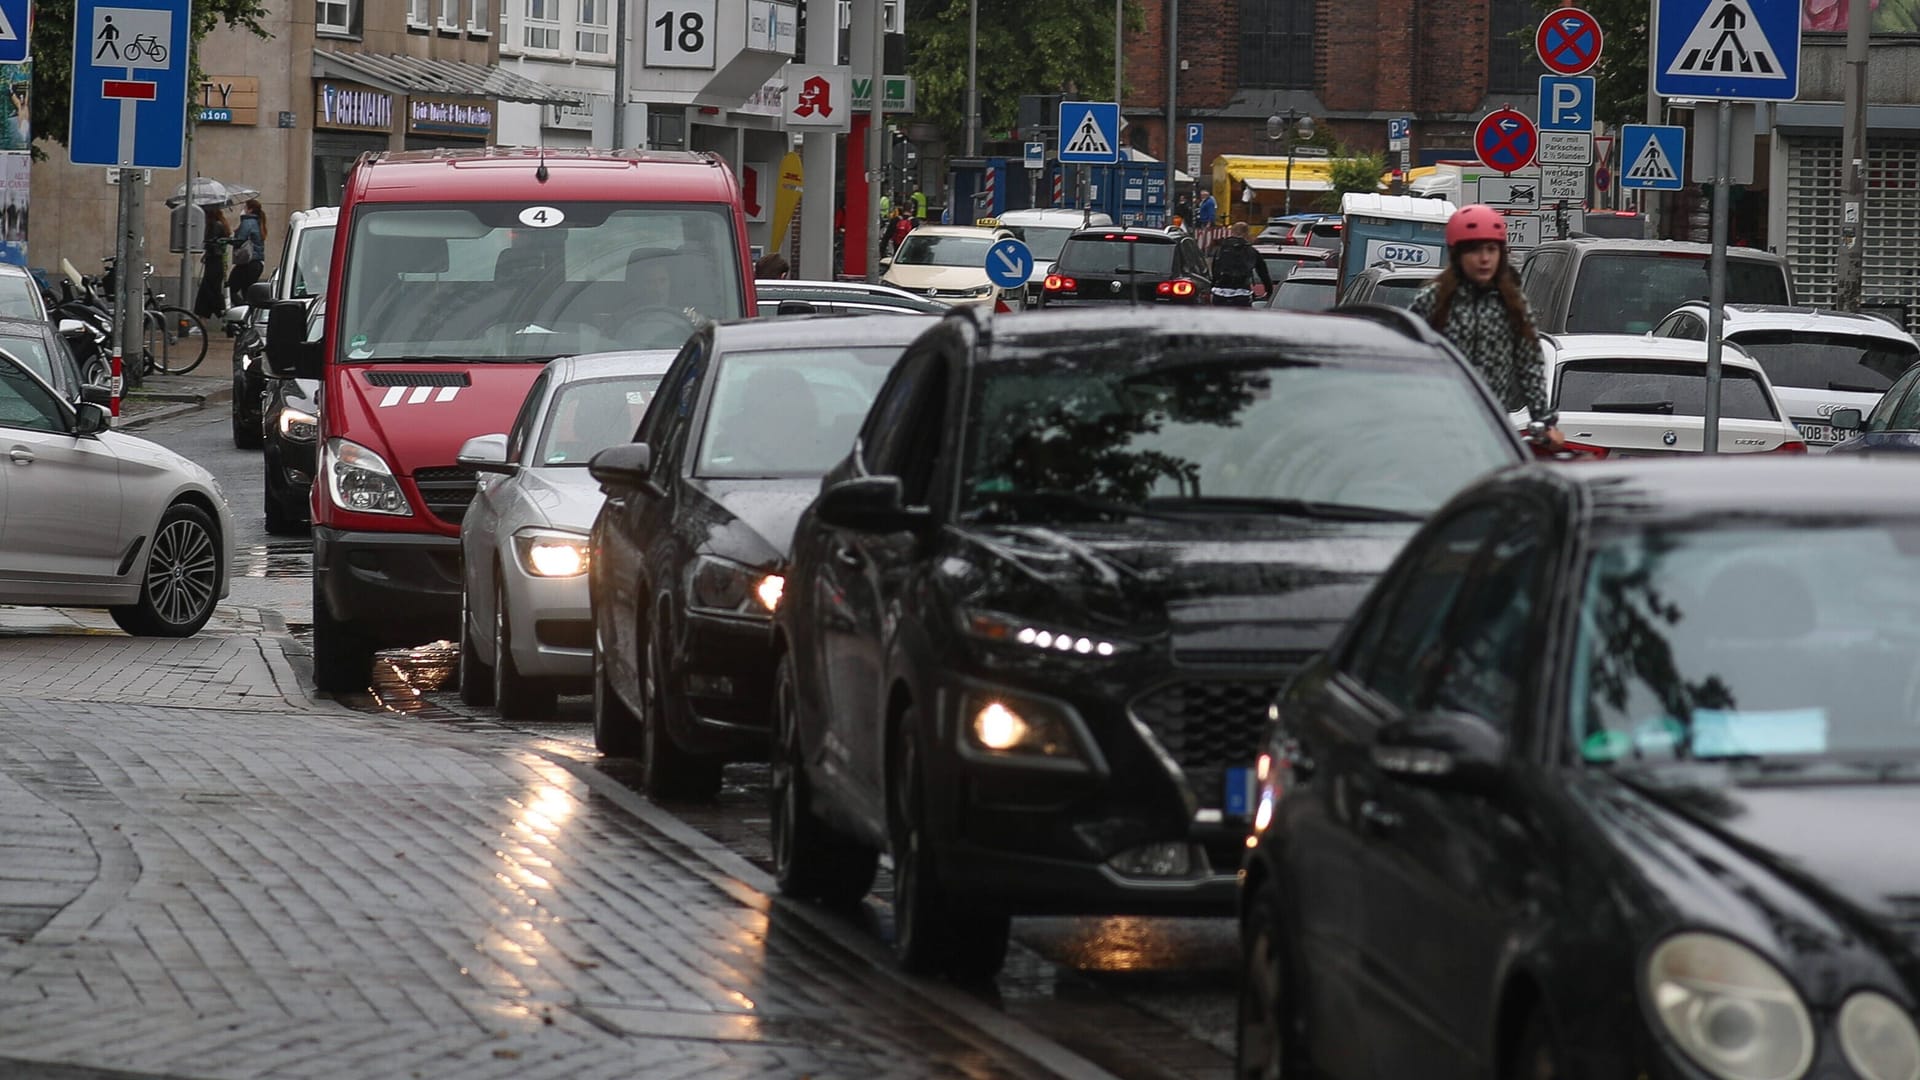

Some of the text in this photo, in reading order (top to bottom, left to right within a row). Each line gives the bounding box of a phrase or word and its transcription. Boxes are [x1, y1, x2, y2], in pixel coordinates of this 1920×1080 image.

[655, 11, 704, 53] 18
[1552, 83, 1582, 124] P
[1189, 126, 1198, 141] P
[1391, 121, 1399, 138] P
[1544, 168, 1584, 179] werktags
[1550, 178, 1577, 187] Mo-Sa
[533, 209, 548, 223] 4
